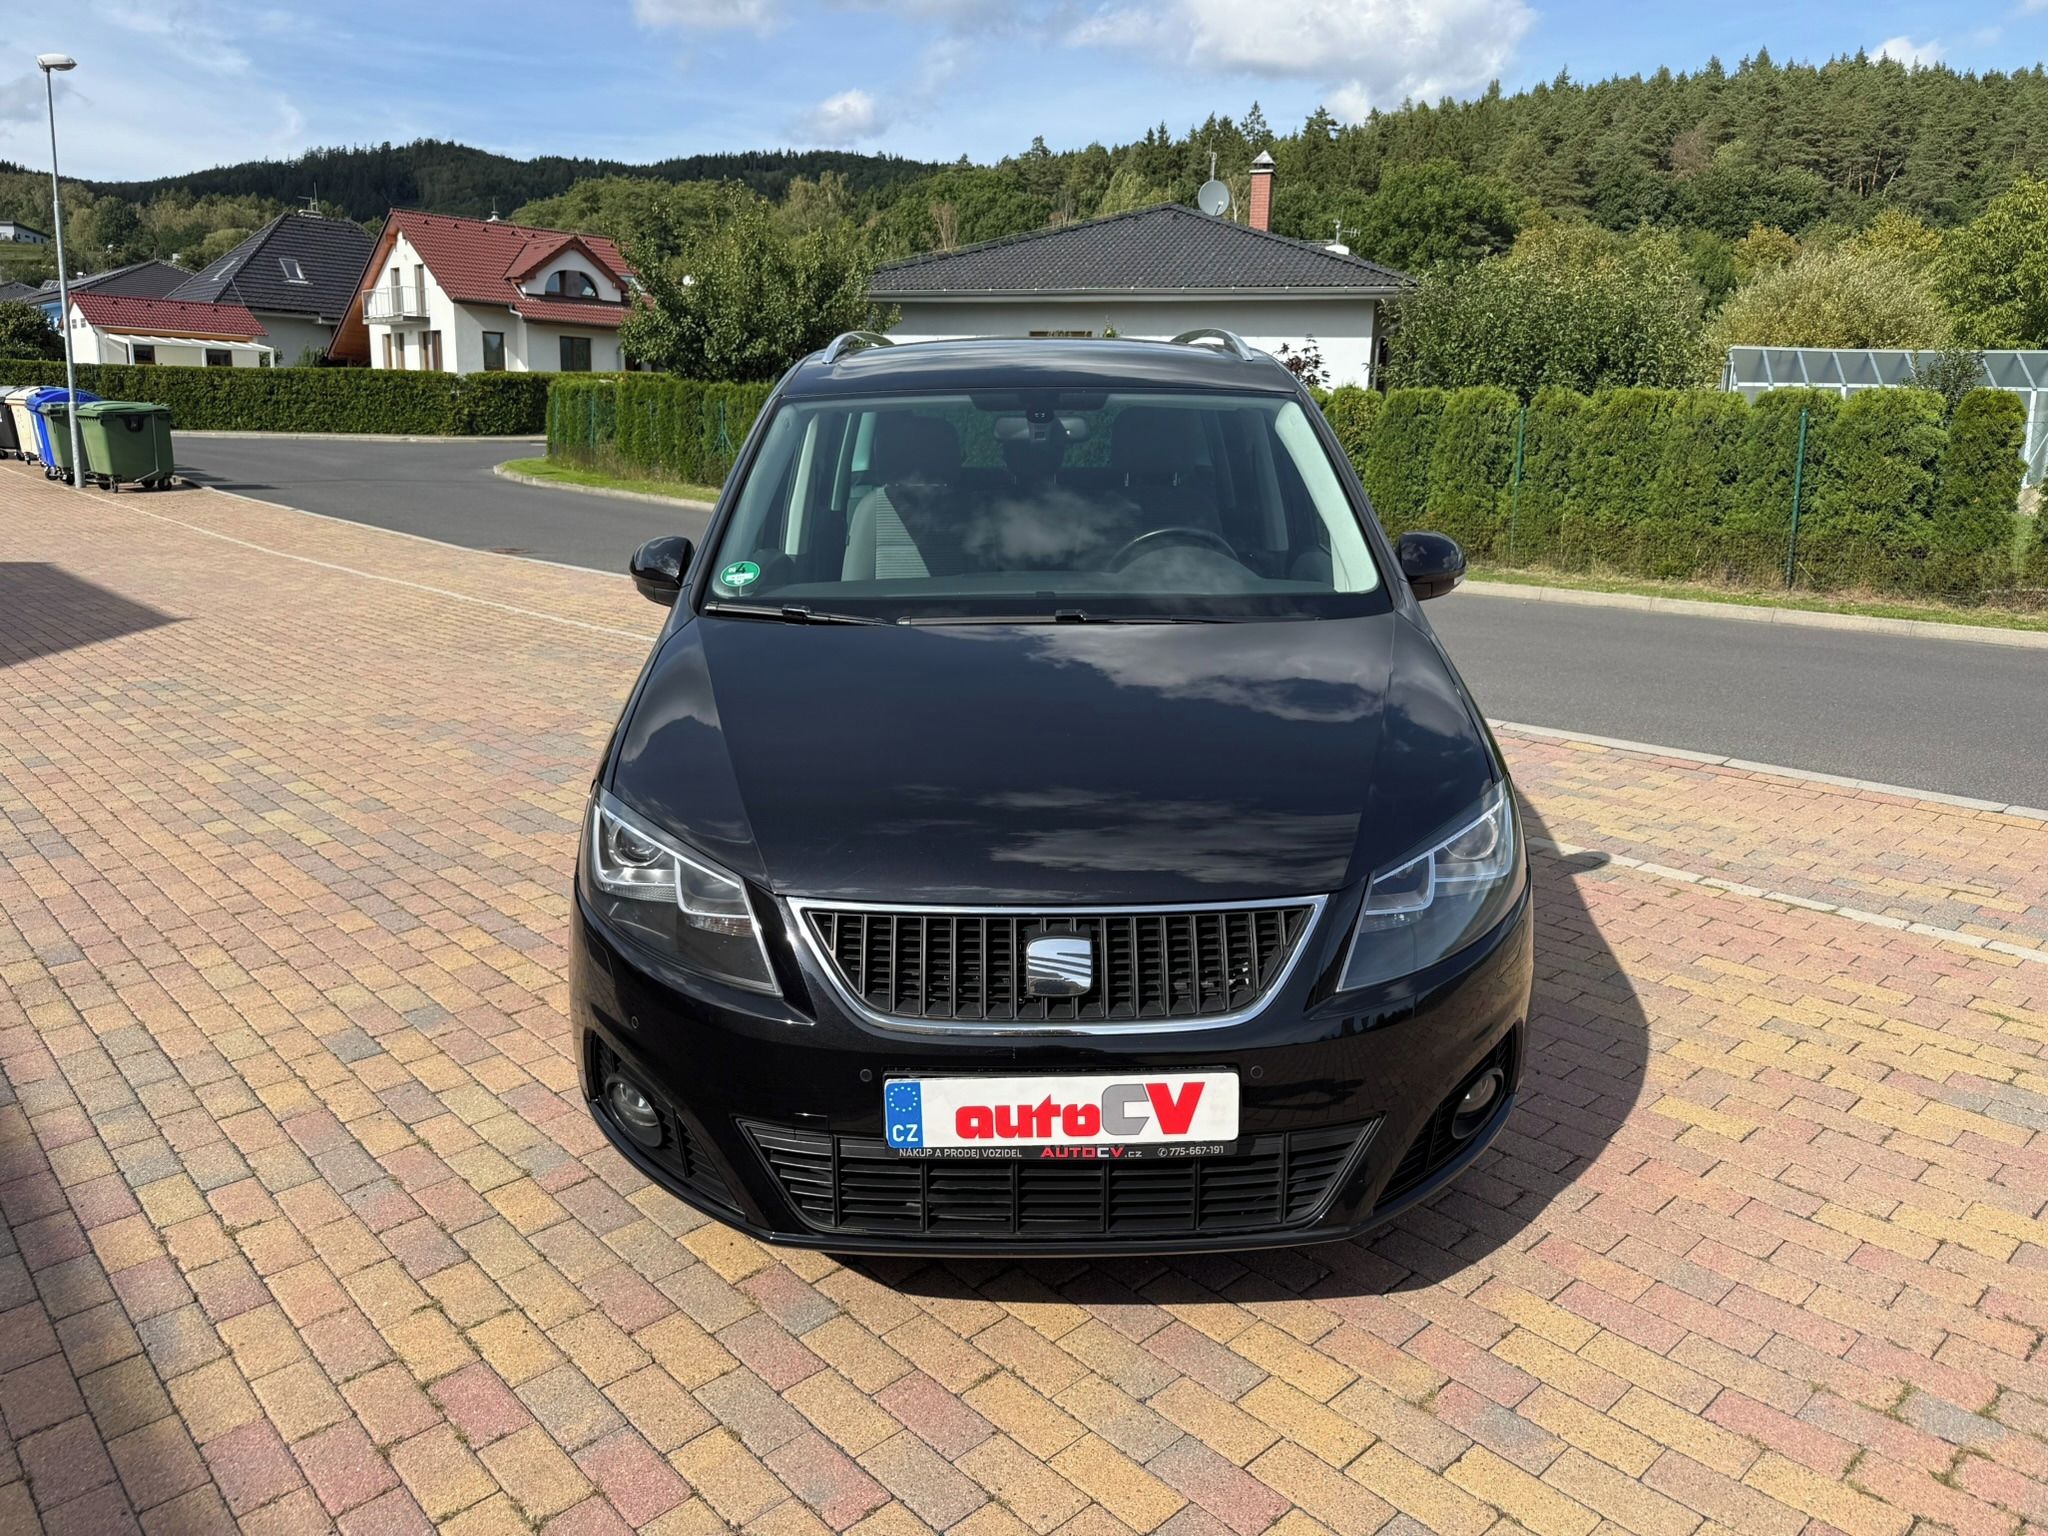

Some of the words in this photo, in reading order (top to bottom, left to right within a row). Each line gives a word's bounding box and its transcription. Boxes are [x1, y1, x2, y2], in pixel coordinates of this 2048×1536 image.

[955, 1081, 1205, 1139] autoCV
[892, 1123, 919, 1142] CZ
[935, 1148, 942, 1158] A
[944, 1148, 980, 1159] PRODEJ
[982, 1148, 1022, 1158] VOZIDEL
[1169, 1145, 1224, 1157] 775-667-191
